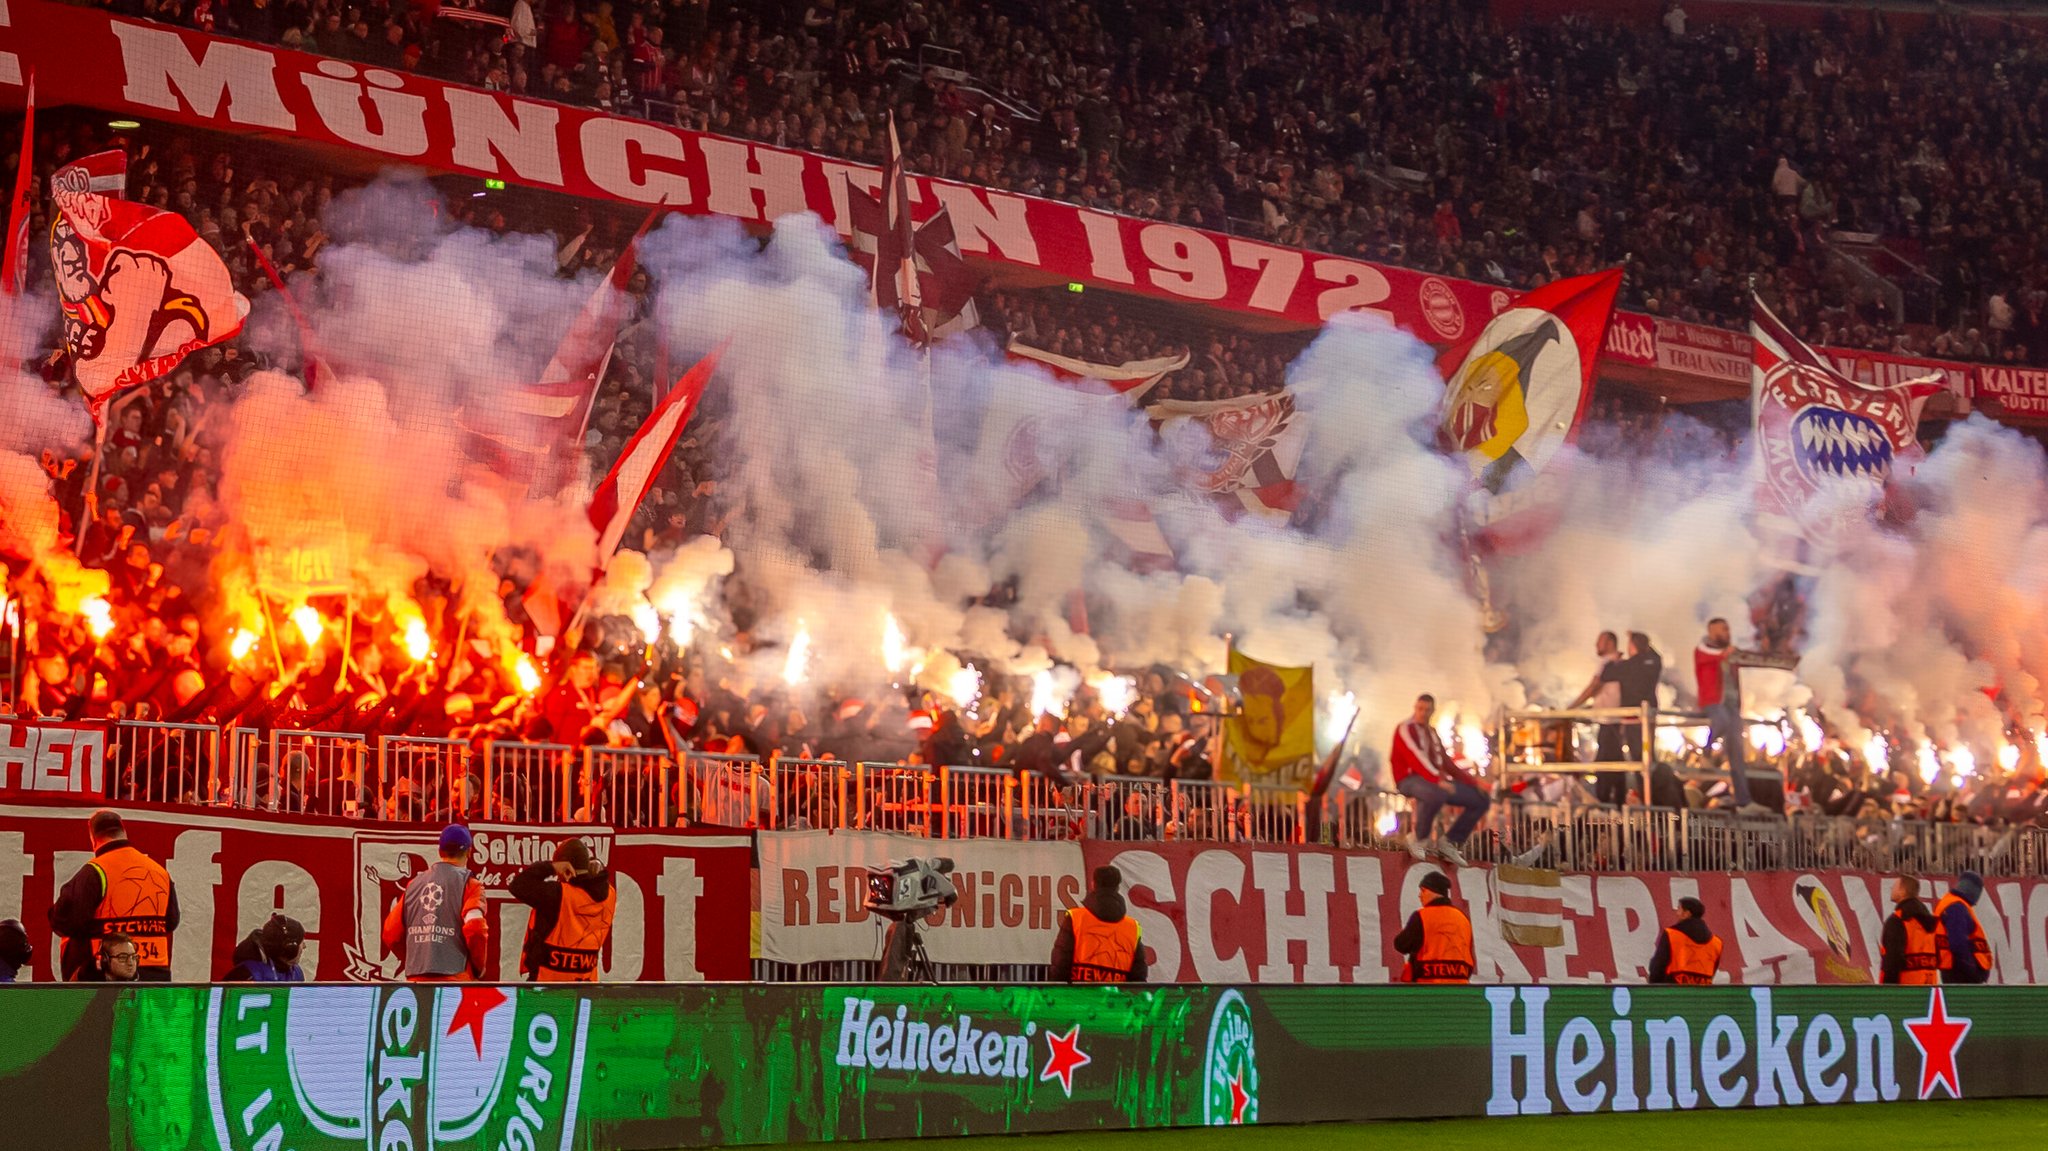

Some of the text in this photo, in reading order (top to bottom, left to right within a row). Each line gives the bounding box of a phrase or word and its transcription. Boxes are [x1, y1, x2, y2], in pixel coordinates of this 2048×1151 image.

[1078, 209, 1396, 328] 1972
[1981, 367, 2048, 397] KALTE
[1999, 393, 2048, 412] SÜDTI
[473, 832, 562, 866] Sektio
[782, 866, 869, 926] RED
[836, 996, 1029, 1078] Heineken
[1484, 985, 1901, 1116] Heineken
